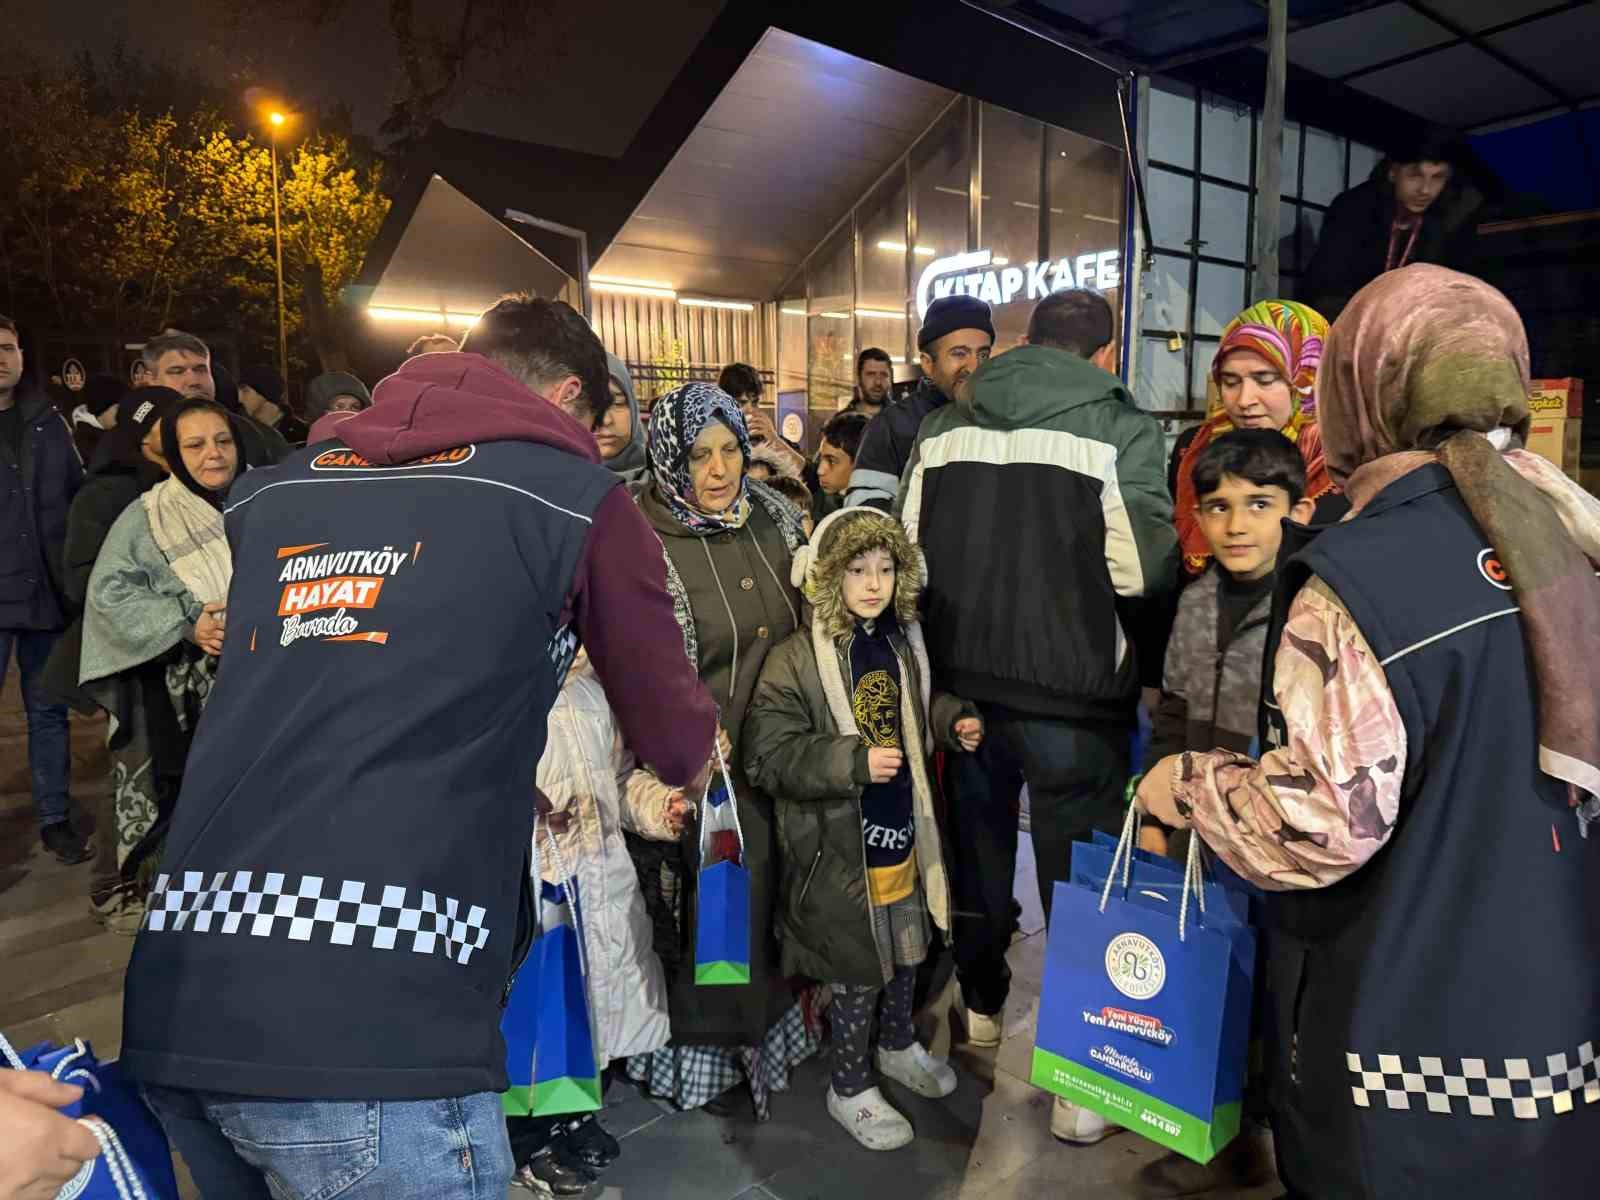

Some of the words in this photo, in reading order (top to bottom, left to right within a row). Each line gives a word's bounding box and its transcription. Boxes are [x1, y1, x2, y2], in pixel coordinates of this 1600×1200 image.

[1025, 250, 1120, 300] KAFE
[278, 546, 409, 582] ARNAVUTKÖY
[284, 580, 377, 611] HAYAT
[280, 607, 359, 647] Burada
[1082, 1010, 1107, 1027] Yeni
[1107, 1018, 1173, 1045] Arnavutköy
